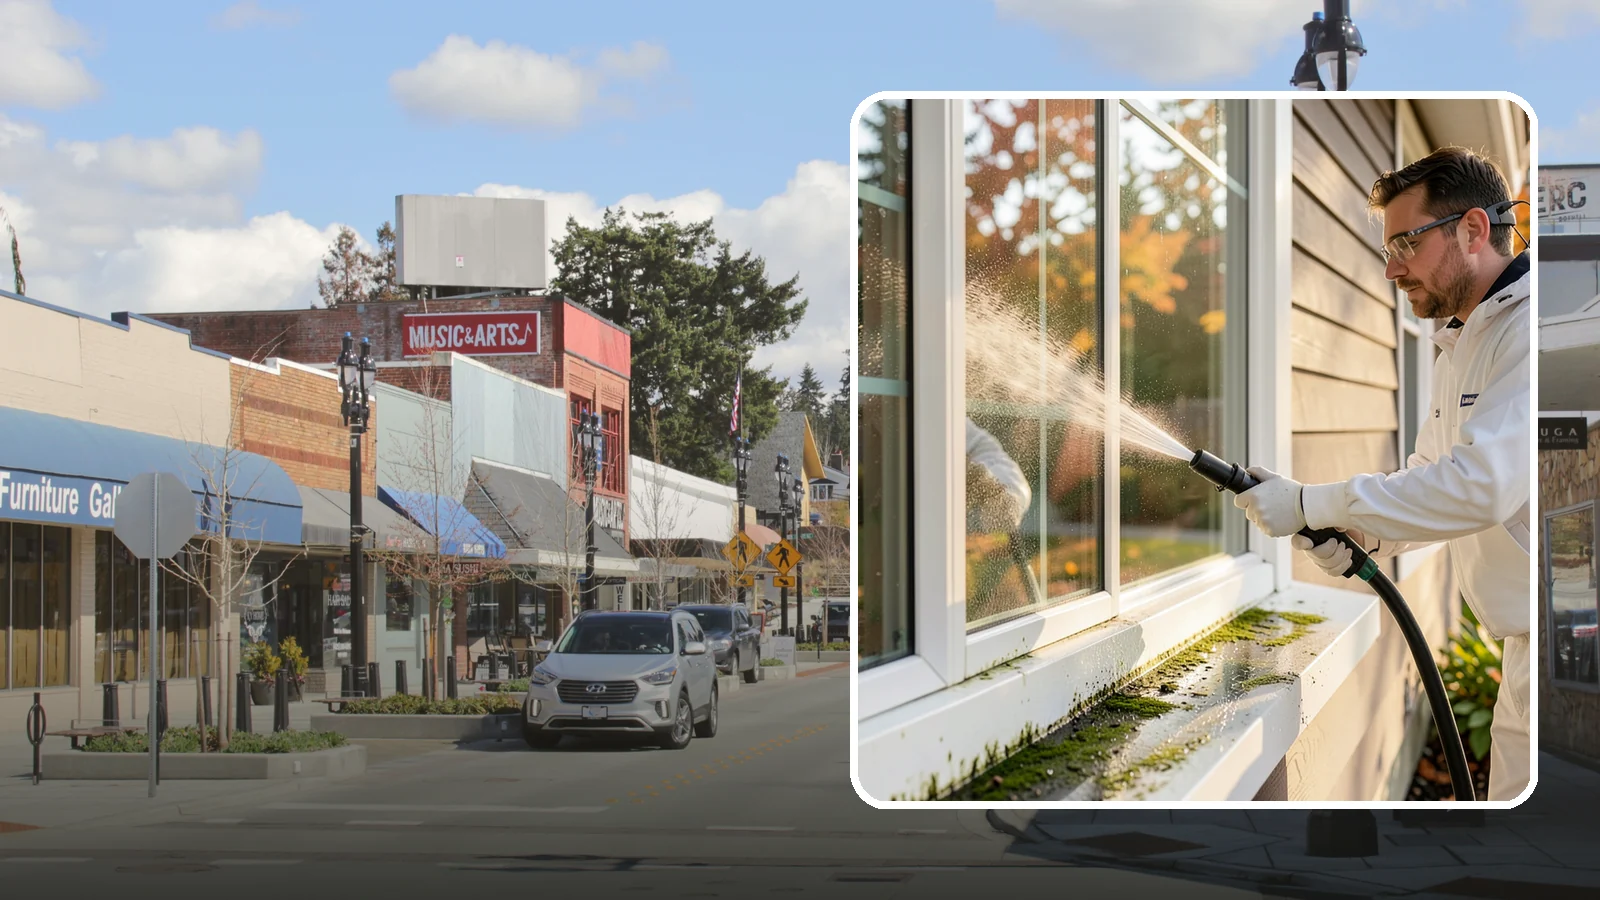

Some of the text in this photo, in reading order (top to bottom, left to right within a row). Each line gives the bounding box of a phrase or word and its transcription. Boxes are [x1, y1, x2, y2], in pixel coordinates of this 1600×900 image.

[408, 322, 520, 349] MUSIC&ARTS
[1540, 427, 1578, 437] UGA
[0, 471, 122, 519] Furniture Gal
[453, 563, 479, 574] SUSHI
